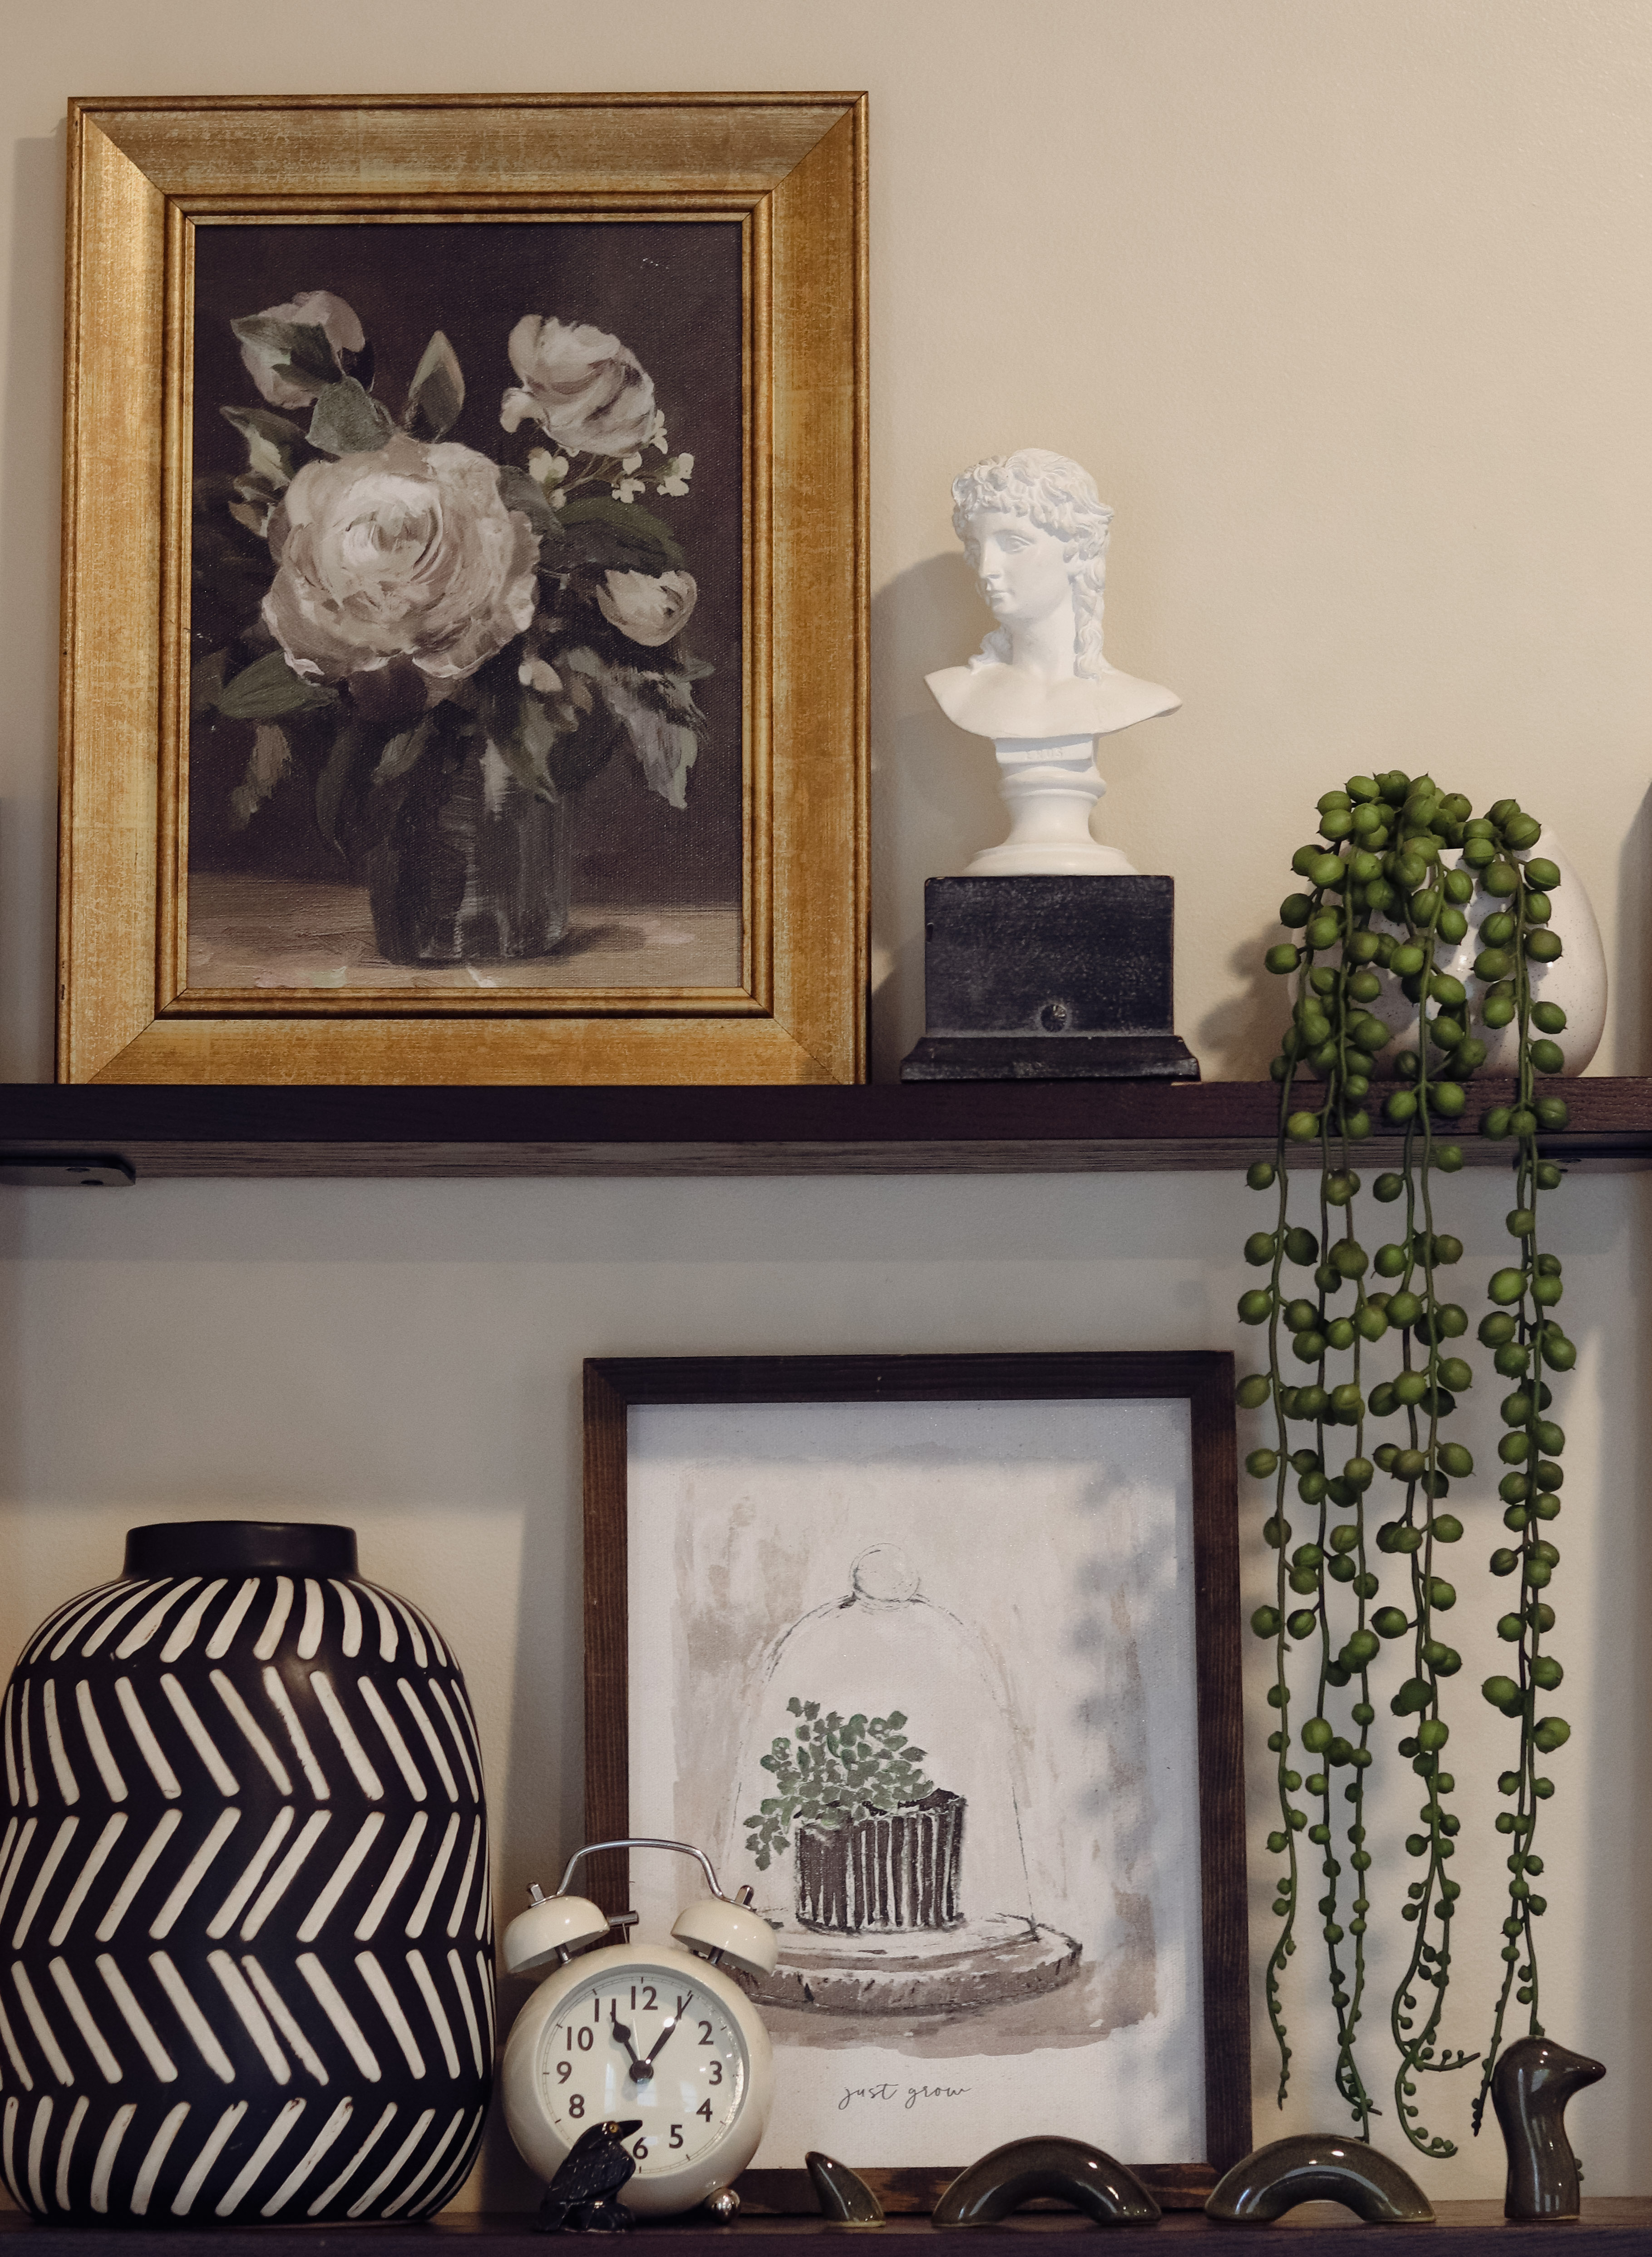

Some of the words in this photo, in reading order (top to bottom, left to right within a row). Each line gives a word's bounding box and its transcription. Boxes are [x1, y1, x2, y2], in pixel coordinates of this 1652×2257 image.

[594, 1998, 616, 2023] 11
[631, 1986, 658, 2010] 12
[677, 1996, 682, 2020] 1
[567, 2026, 594, 2051] 10
[698, 2020, 714, 2045] 2
[556, 2061, 572, 2084] 9
[709, 2060, 723, 2085] 3
[568, 2094, 585, 2119] 8
[838, 2083, 899, 2110] just
[905, 2085, 972, 2109] grow
[696, 2098, 713, 2122] 4
[633, 2137, 648, 2159] 6
[669, 2124, 684, 2149] 5
